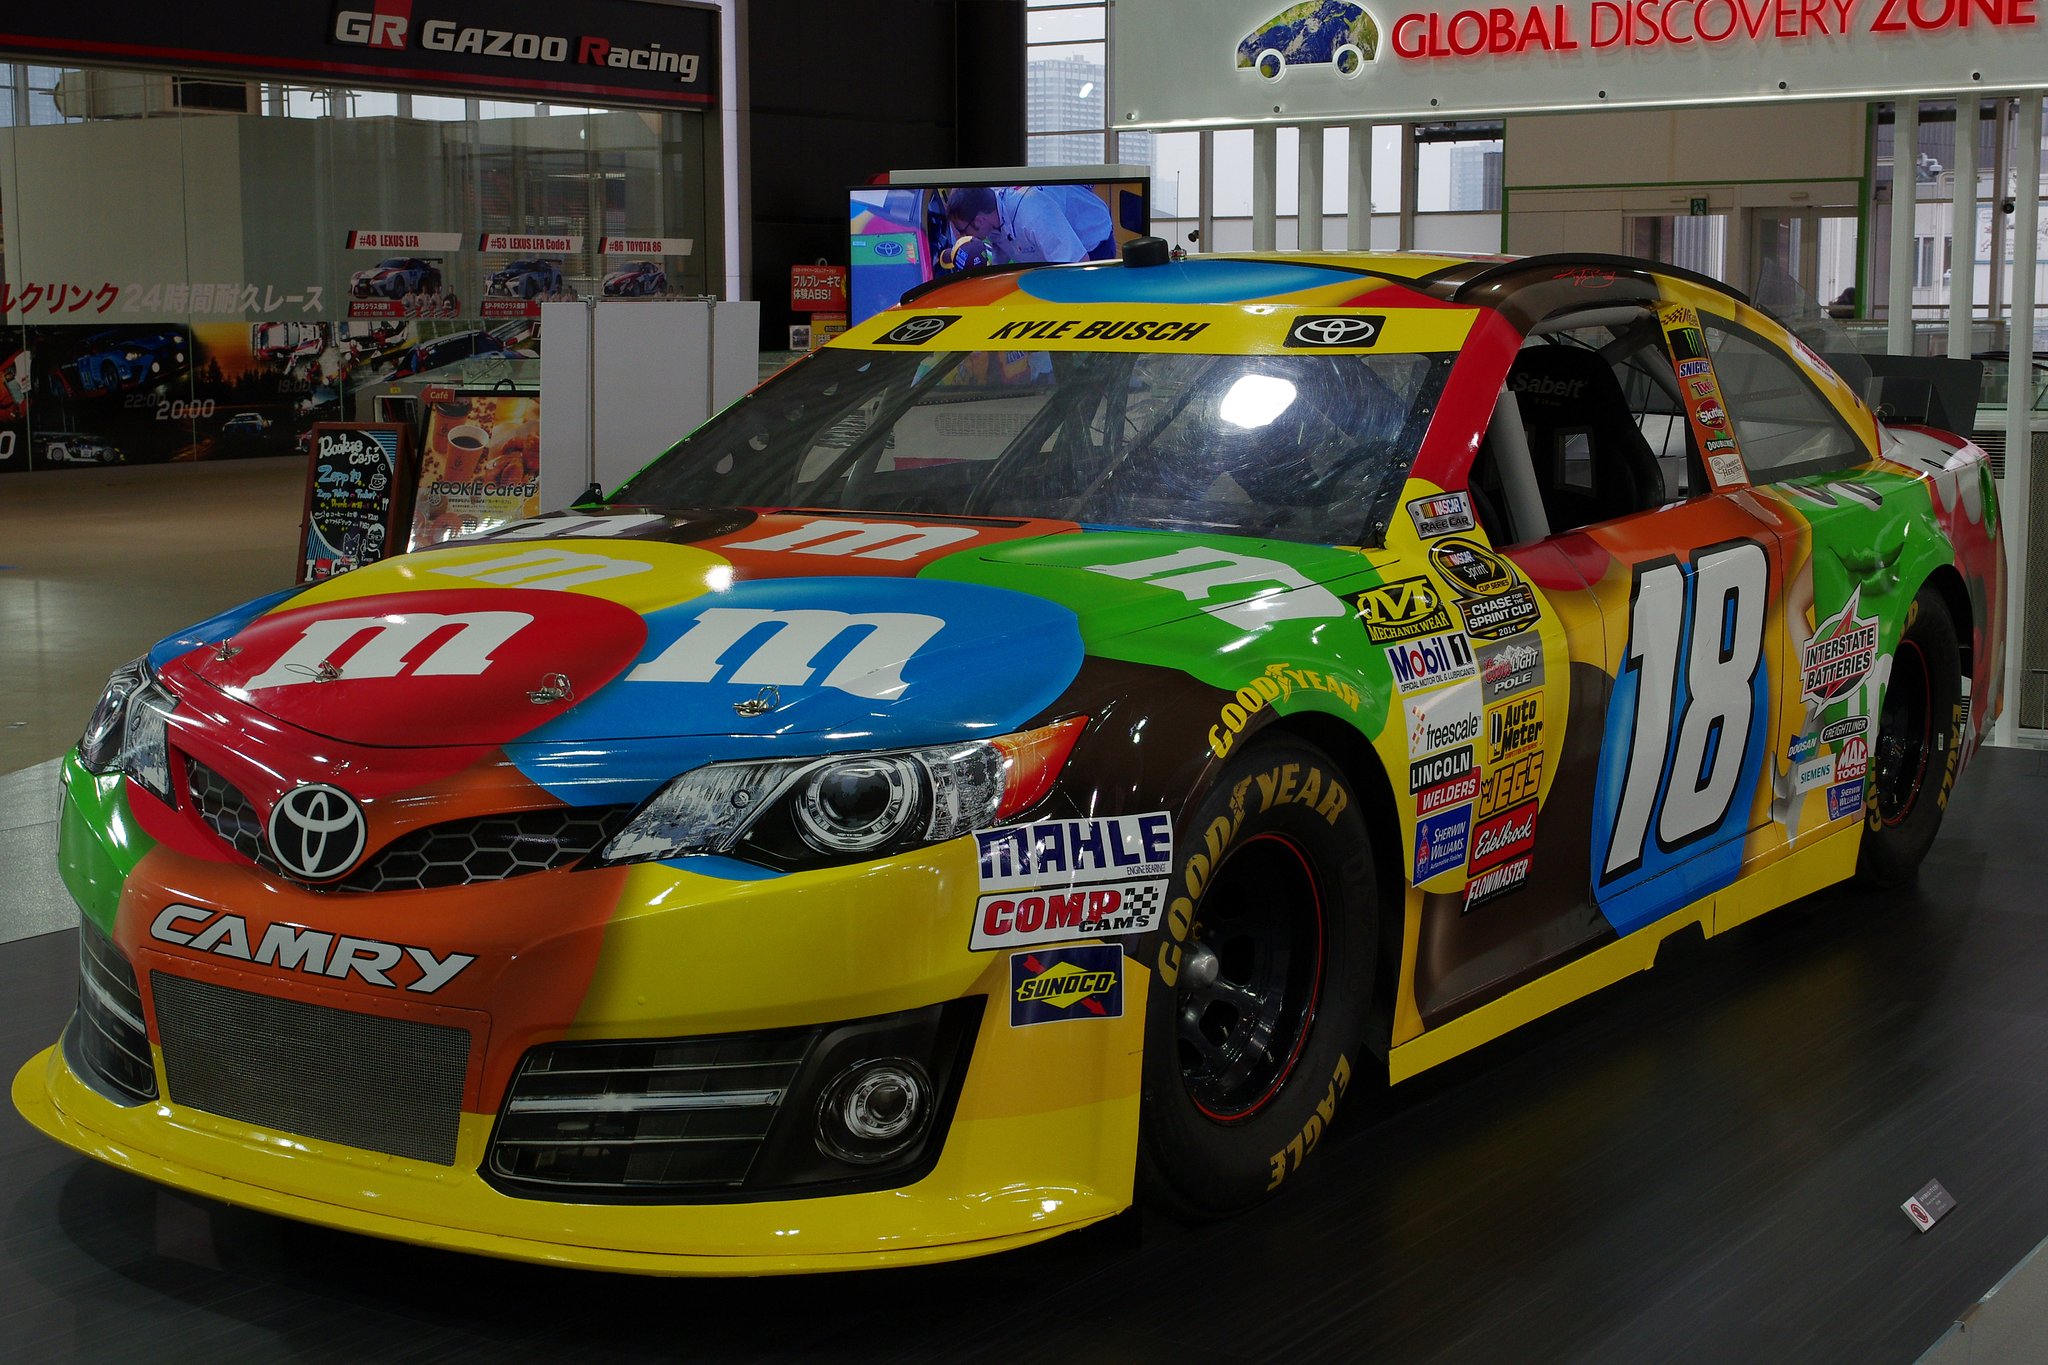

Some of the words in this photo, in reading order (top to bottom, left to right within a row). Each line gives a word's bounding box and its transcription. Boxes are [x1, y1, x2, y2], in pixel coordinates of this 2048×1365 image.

[1392, 4, 1578, 58] GLOBAL
[1590, 0, 1855, 47] DISCOVERY
[335, 10, 408, 49] GR
[421, 18, 569, 63] GAZOO
[577, 34, 701, 84] Racing
[360, 234, 377, 247] #48
[380, 234, 404, 248] LEXUS
[405, 235, 420, 248] LFA
[490, 237, 507, 249] #53
[509, 238, 532, 250] LEXUS
[532, 238, 545, 250] LFA
[545, 238, 565, 251] Code
[608, 240, 624, 252] #86
[626, 240, 652, 253] TOYOTA
[652, 241, 662, 253] 86
[793, 274, 841, 289] フルブレーキで
[121, 282, 325, 315] 24時間耐久レース
[793, 288, 833, 301] 体験ABS!
[988, 320, 1082, 341] KYLE
[1071, 320, 1212, 342] BUSCH
[429, 390, 449, 400] Café
[1511, 371, 1585, 400] Sabelt
[155, 398, 216, 420] 20:00
[430, 481, 483, 496] ROOKIE
[484, 482, 523, 498] Café
[1433, 497, 1462, 516] NASCAR
[1448, 515, 1472, 528] CAR
[1449, 550, 1475, 566] NASCAR
[1463, 562, 1489, 581] Sprint
[1478, 583, 1490, 593] CUP
[1512, 591, 1523, 601] FOR
[1469, 608, 1511, 629] SPRINT
[1511, 602, 1534, 617] CUP
[1470, 595, 1512, 617] CHASE
[1367, 623, 1422, 642] MECHANIX
[1418, 611, 1450, 634] WEAR
[1498, 624, 1517, 637] 2014
[240, 610, 536, 692] m
[624, 608, 948, 701] m
[1805, 627, 1875, 668] INTERSTATE
[1388, 637, 1451, 684] Mobil
[1510, 649, 1540, 674] LIGHT
[1807, 651, 1871, 691] BATTERIES
[1418, 676, 1437, 689] MOTOR
[1448, 667, 1476, 680] LUBRICANTS
[1493, 671, 1533, 695] POLE
[1208, 662, 1361, 760] GOODYEAR
[1504, 700, 1537, 729] Auto
[1600, 537, 1769, 888] 18
[1426, 712, 1478, 751] freescale
[1502, 720, 1543, 752] Meter
[1823, 718, 1867, 742] FREIGHTLINER
[1787, 737, 1818, 758] DOOSAN
[1411, 751, 1471, 790] LINCOLN
[1800, 764, 1831, 785] SIEMENS
[1836, 764, 1867, 782] TOOLS
[1422, 778, 1477, 812] WELDERS
[1432, 820, 1467, 845] SHERWIN
[1474, 812, 1534, 861] Edelbrock
[975, 815, 1171, 880] MAHLE
[1430, 838, 1465, 862] WILLIAMS
[1157, 762, 1349, 988] GOODYEAR
[1463, 858, 1530, 913] FLOWMASTER
[983, 890, 1122, 936] COMP
[1078, 914, 1150, 933] CAMS
[149, 902, 480, 994] CAMRY
[1019, 973, 1113, 1000] SUNOCO
[1266, 1052, 1352, 1192] EAGLE
